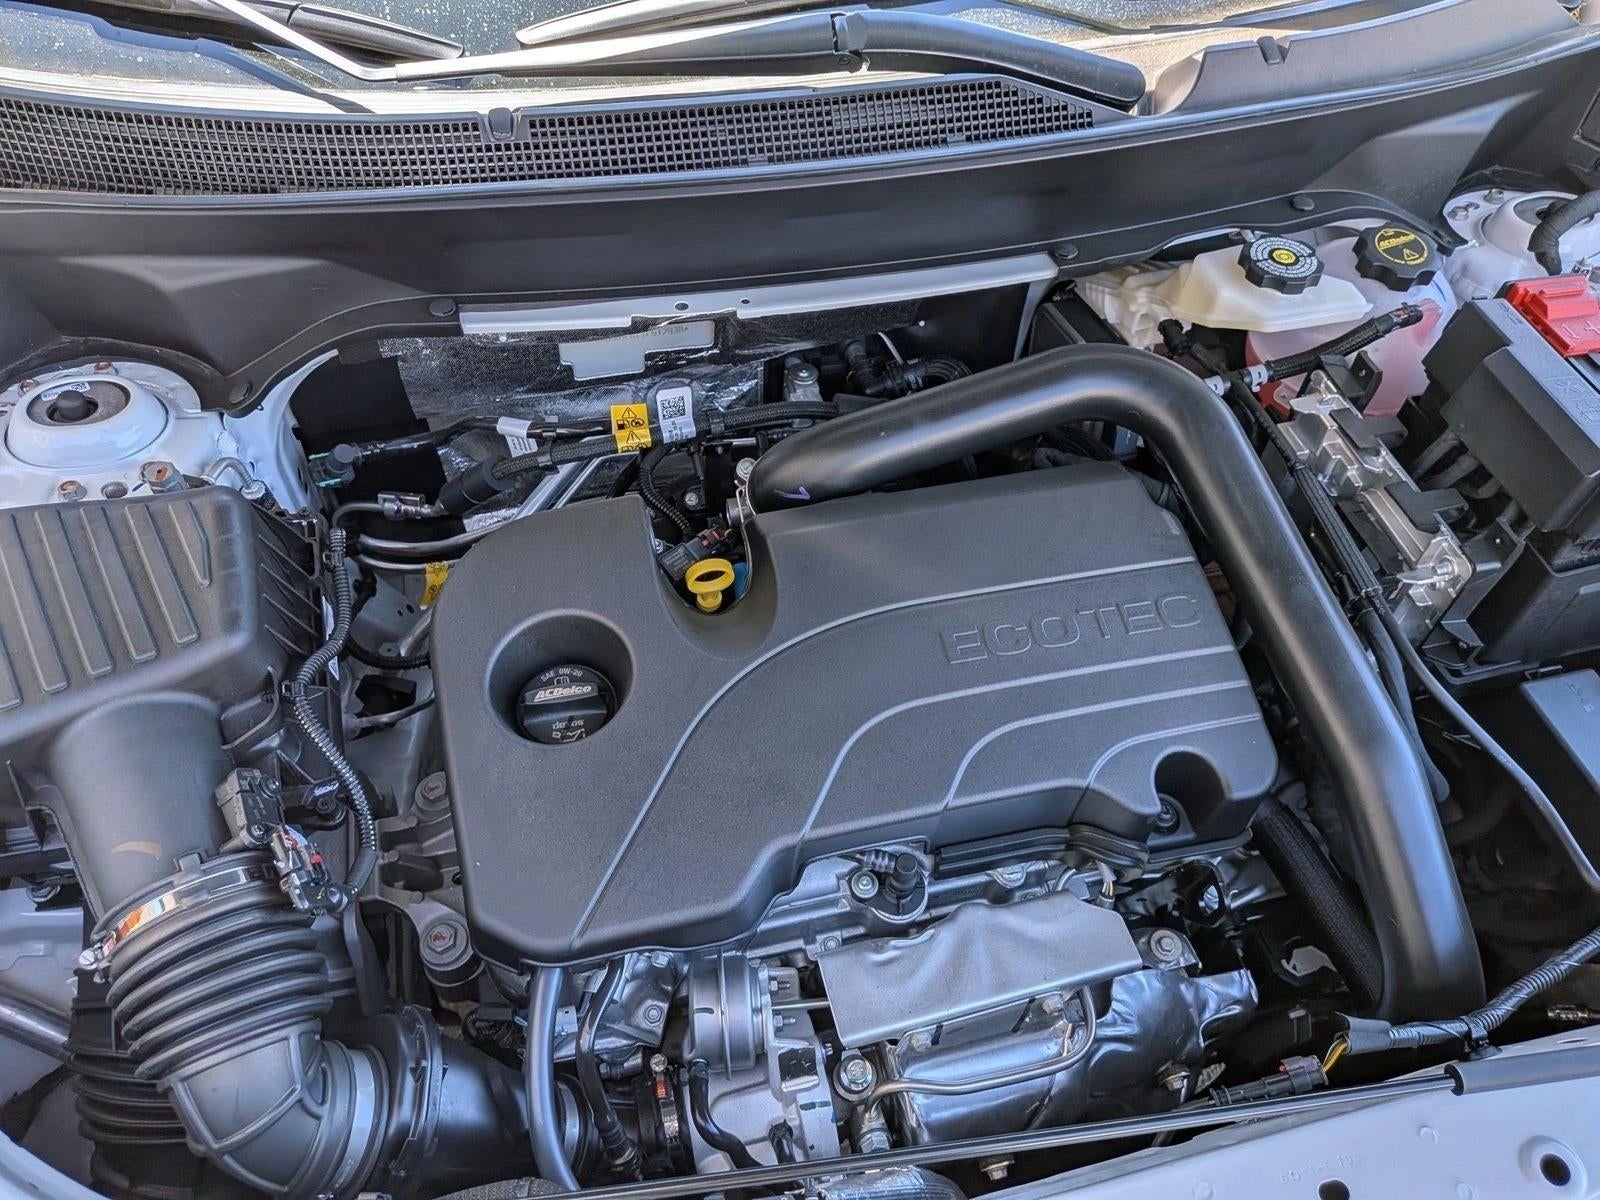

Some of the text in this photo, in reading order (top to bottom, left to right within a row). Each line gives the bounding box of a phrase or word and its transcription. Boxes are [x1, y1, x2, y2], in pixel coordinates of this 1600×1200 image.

[939, 594, 1203, 664] ECOTEC
[541, 667, 583, 681] SAE 0W-20
[534, 685, 592, 702] ACDelco
